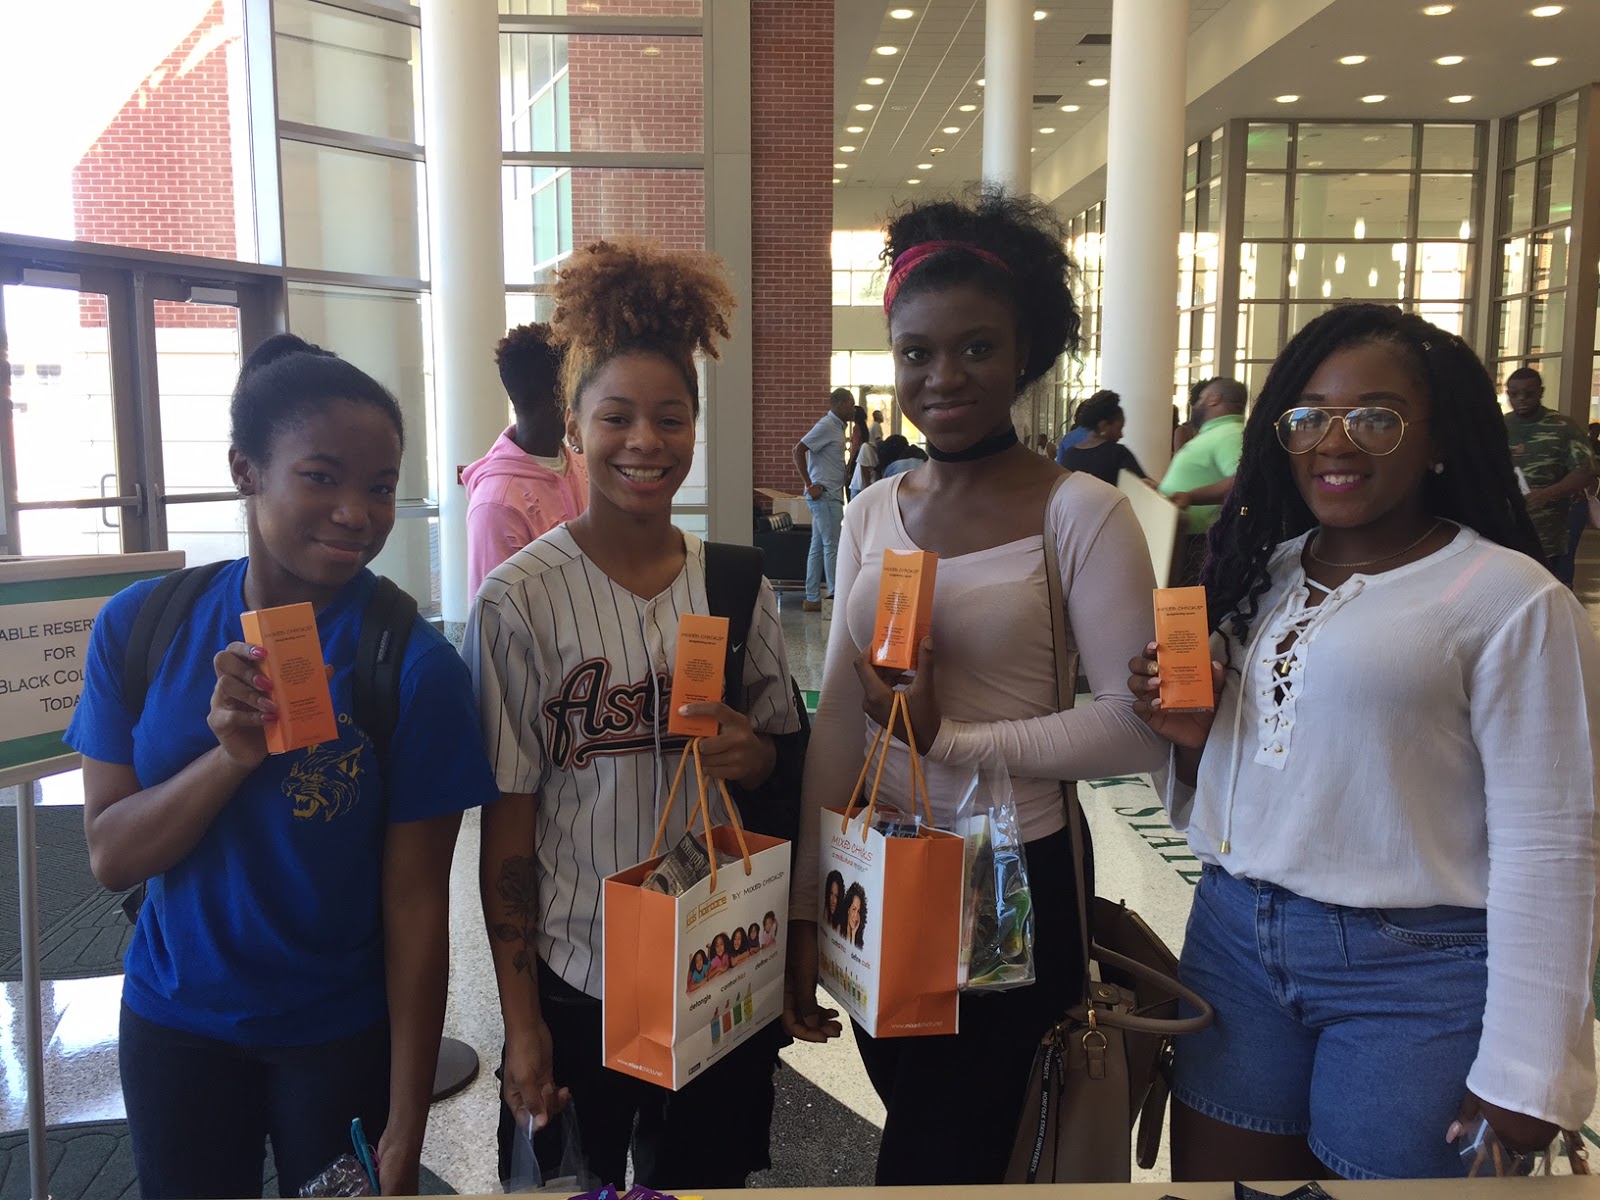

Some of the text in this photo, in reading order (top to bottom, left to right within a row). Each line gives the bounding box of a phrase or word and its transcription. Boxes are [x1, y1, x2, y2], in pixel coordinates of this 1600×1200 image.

[43, 619, 95, 636] RESER
[44, 646, 76, 661] FOR
[0, 674, 50, 694] BLACK
[831, 835, 851, 850] MIXED
[731, 891, 741, 901] BY
[743, 882, 762, 896] MIXED
[720, 979, 737, 992] control
[689, 994, 712, 1012] detangle
[1040, 1091, 1048, 1118] NORFOLK
[1037, 1118, 1046, 1136] STATE
